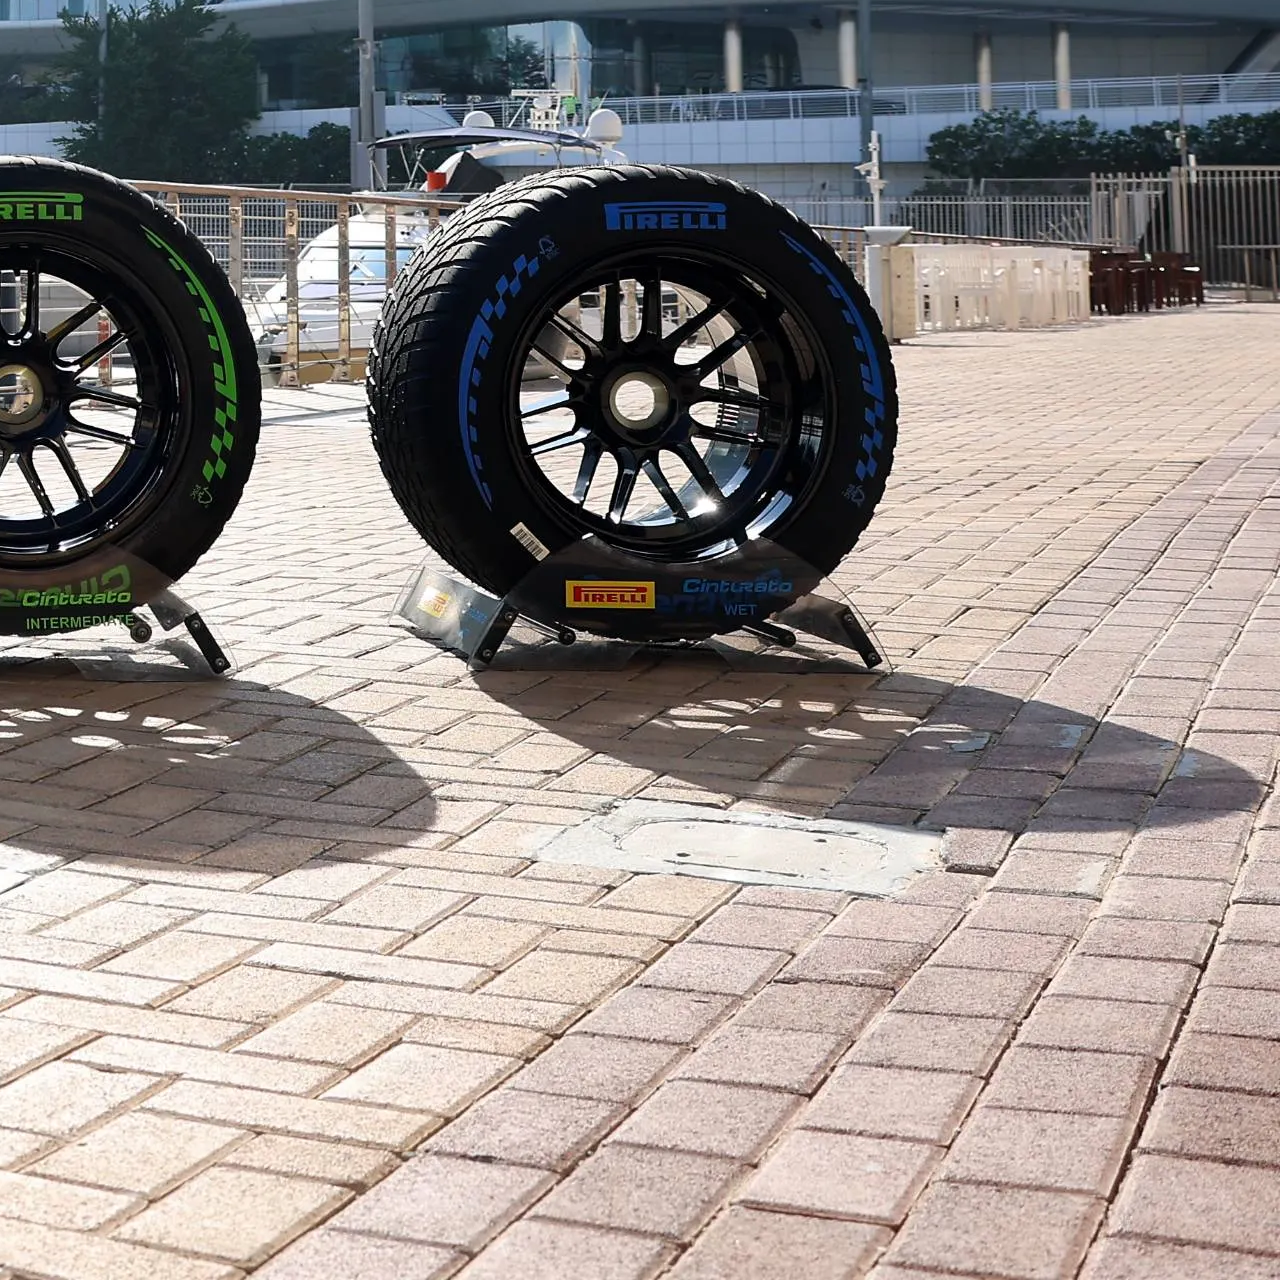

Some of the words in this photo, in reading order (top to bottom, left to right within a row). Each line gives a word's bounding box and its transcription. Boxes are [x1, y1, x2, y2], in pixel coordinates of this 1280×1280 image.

[603, 201, 727, 230] PIRELLI
[682, 578, 793, 593] Cinturato
[22, 591, 131, 607] Cinturato
[573, 585, 648, 603] PIRELLI
[724, 604, 757, 616] WET
[26, 614, 134, 630] INTERMEDIATE
